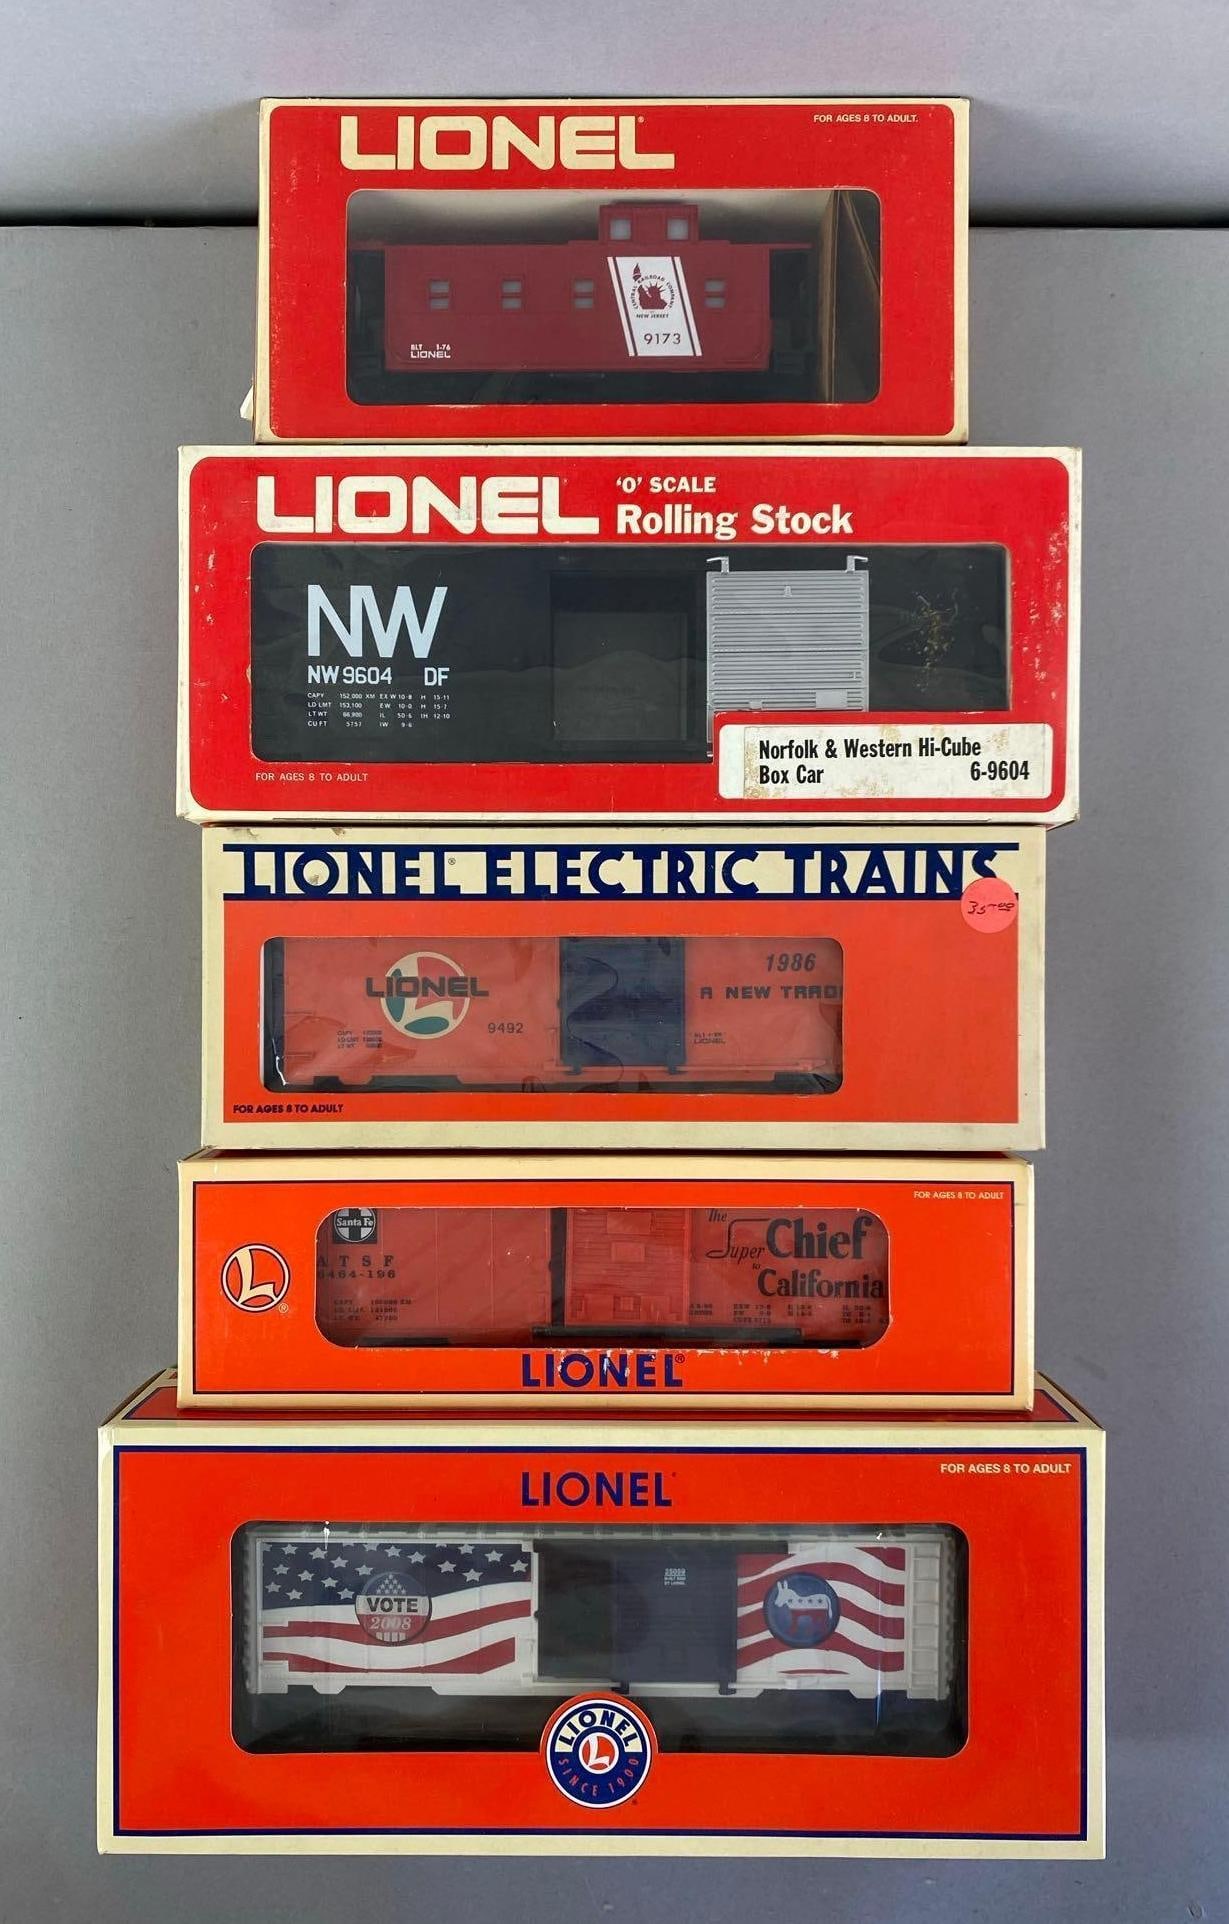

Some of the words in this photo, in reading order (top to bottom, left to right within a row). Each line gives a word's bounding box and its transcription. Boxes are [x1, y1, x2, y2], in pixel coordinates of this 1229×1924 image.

[813, 114, 833, 122] FOR
[836, 114, 861, 122] AGES
[863, 114, 870, 122] 8
[872, 114, 885, 122] TO
[340, 115, 675, 170] LIONEL
[643, 333, 681, 345] 9173
[410, 350, 451, 359] LIONEL
[649, 476, 717, 494] SCALE
[256, 475, 600, 535] LIONEL
[616, 503, 739, 541] Rolling
[750, 503, 854, 535] Stock
[307, 584, 449, 659] NW
[307, 665, 340, 684] NW
[342, 666, 393, 685] 9604
[423, 666, 450, 686] DF
[759, 739, 819, 759] Norfolk
[825, 739, 838, 758] &
[844, 738, 912, 757] Western
[918, 736, 982, 756] Hi-Cube
[255, 772, 275, 781] FOR
[279, 772, 305, 781] AGES
[308, 772, 316, 781] 8
[319, 772, 333, 781] TO
[336, 773, 369, 782] ADULT
[759, 765, 790, 784] Box
[796, 764, 825, 783] Car
[970, 760, 1030, 781] 6-9604
[243, 845, 462, 900] LIONEL
[486, 845, 761, 900] ELECTRIC
[766, 953, 816, 972] 1986
[365, 976, 490, 998] LIONEL
[700, 986, 712, 999] A
[725, 986, 771, 999] NEW
[487, 1022, 524, 1034] 9492
[232, 1104, 254, 1114] FOR
[256, 1104, 285, 1114] AGES
[286, 1104, 293, 1113] 8
[295, 1104, 309, 1113] TO
[310, 1104, 344, 1113] ADULT
[913, 1190, 931, 1199] FOR
[933, 1190, 956, 1199] AGES
[957, 1191, 963, 1199] 8
[965, 1191, 976, 1199] TO
[978, 1191, 1005, 1200] ADULT
[336, 1217, 362, 1228] Santa
[363, 1217, 375, 1227] Fe
[706, 1218, 772, 1264] Super
[766, 1215, 874, 1260] Chief
[758, 1268, 886, 1299] California
[521, 1353, 685, 1388] LIONEL
[940, 1463, 965, 1473] FOR
[968, 1463, 1001, 1473] AGES
[1003, 1463, 1011, 1474] 8
[1013, 1463, 1030, 1474] TO
[1033, 1463, 1072, 1474] ADULT
[521, 1471, 673, 1507] LIONEL
[366, 1597, 418, 1613] VOTE
[558, 1709, 639, 1747] LIONEL
[558, 1758, 600, 1797] SINCE
[608, 1758, 640, 1794] 1900
